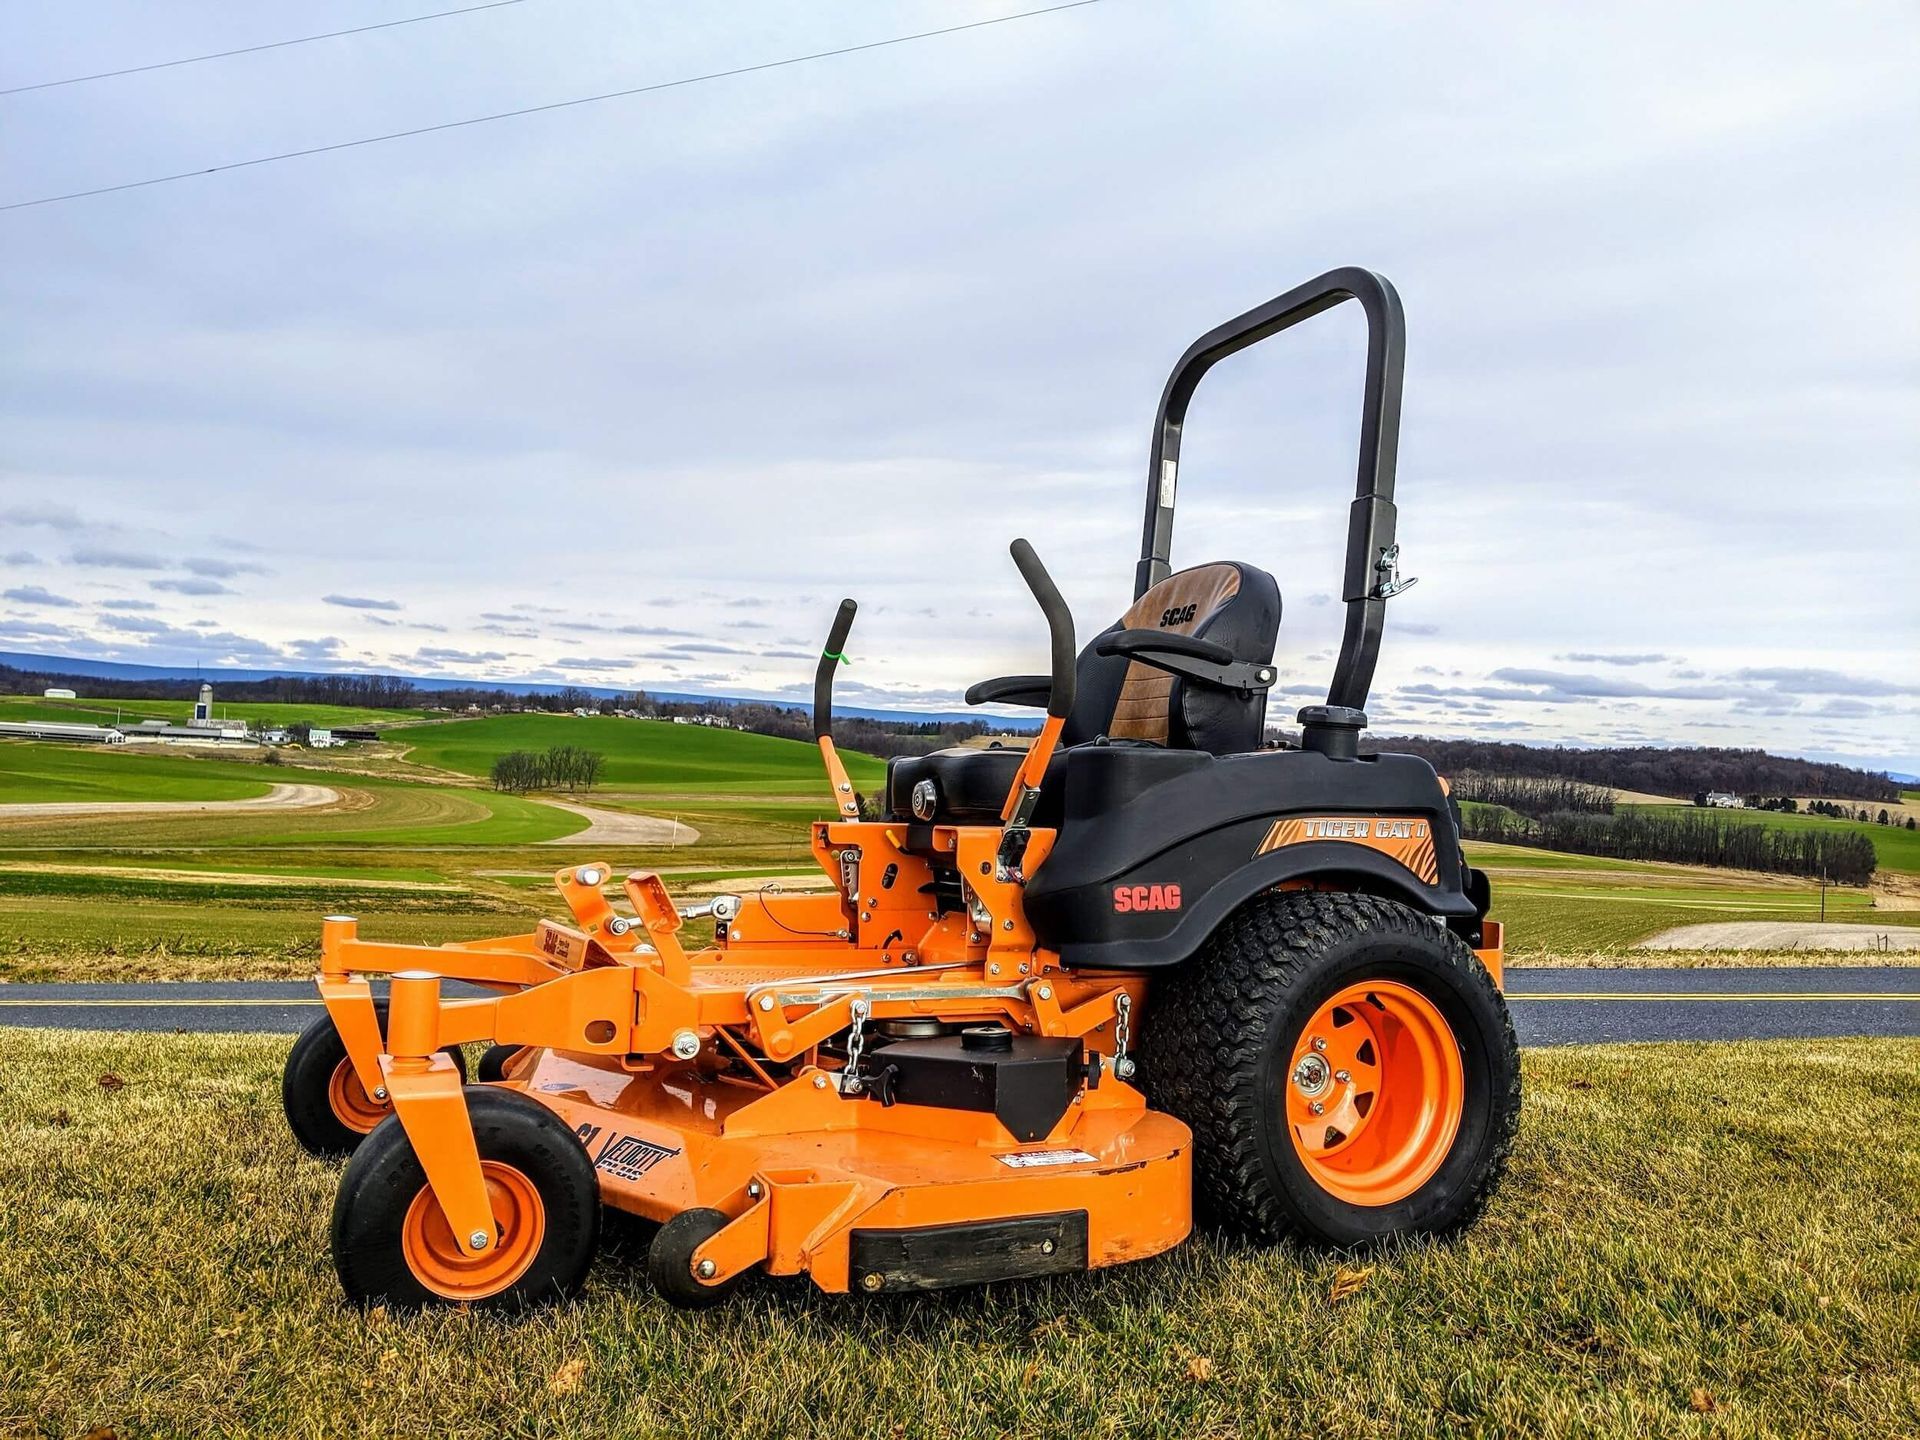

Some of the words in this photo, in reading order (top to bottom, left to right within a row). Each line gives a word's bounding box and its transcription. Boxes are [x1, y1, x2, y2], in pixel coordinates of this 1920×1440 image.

[1160, 604, 1197, 627] SCAG
[1304, 820, 1370, 838] TIGER
[1375, 821, 1415, 839] CAT
[1114, 884, 1181, 912] SCAG
[594, 1132, 681, 1171] VELOCITY
